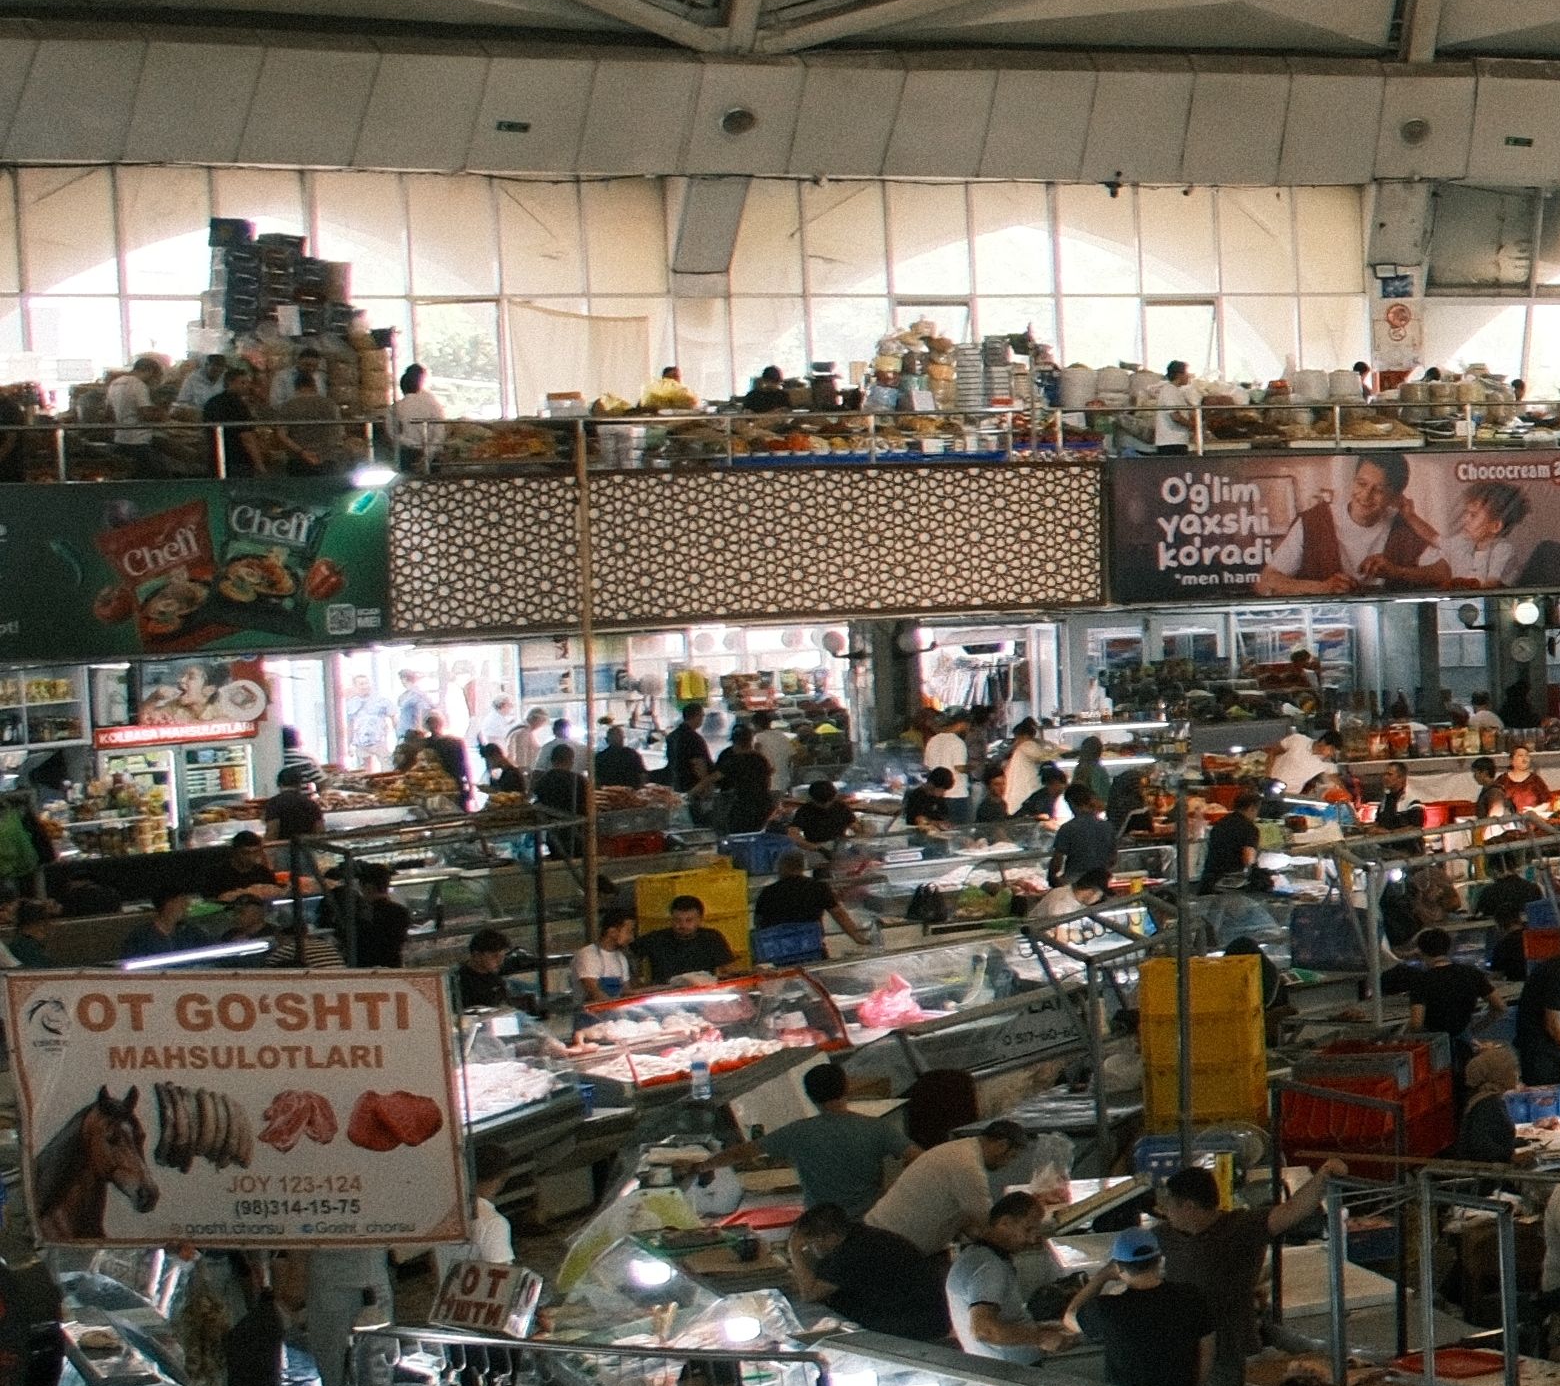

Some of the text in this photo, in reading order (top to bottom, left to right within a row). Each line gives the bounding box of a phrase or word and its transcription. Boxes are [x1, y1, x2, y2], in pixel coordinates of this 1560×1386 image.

[1458, 463, 1551, 481] Chococream
[1161, 472, 1262, 514] O'g'lim
[1157, 507, 1270, 544] yaxshi
[1157, 536, 1273, 571] ko'radi
[1223, 570, 1262, 584] ham
[76, 990, 412, 1034] OT GO‘SHTI
[108, 1044, 386, 1071] MAHSULOTLARI
[227, 1174, 363, 1195] JOY 123-124
[234, 1198, 362, 1220] (98)314-15-75
